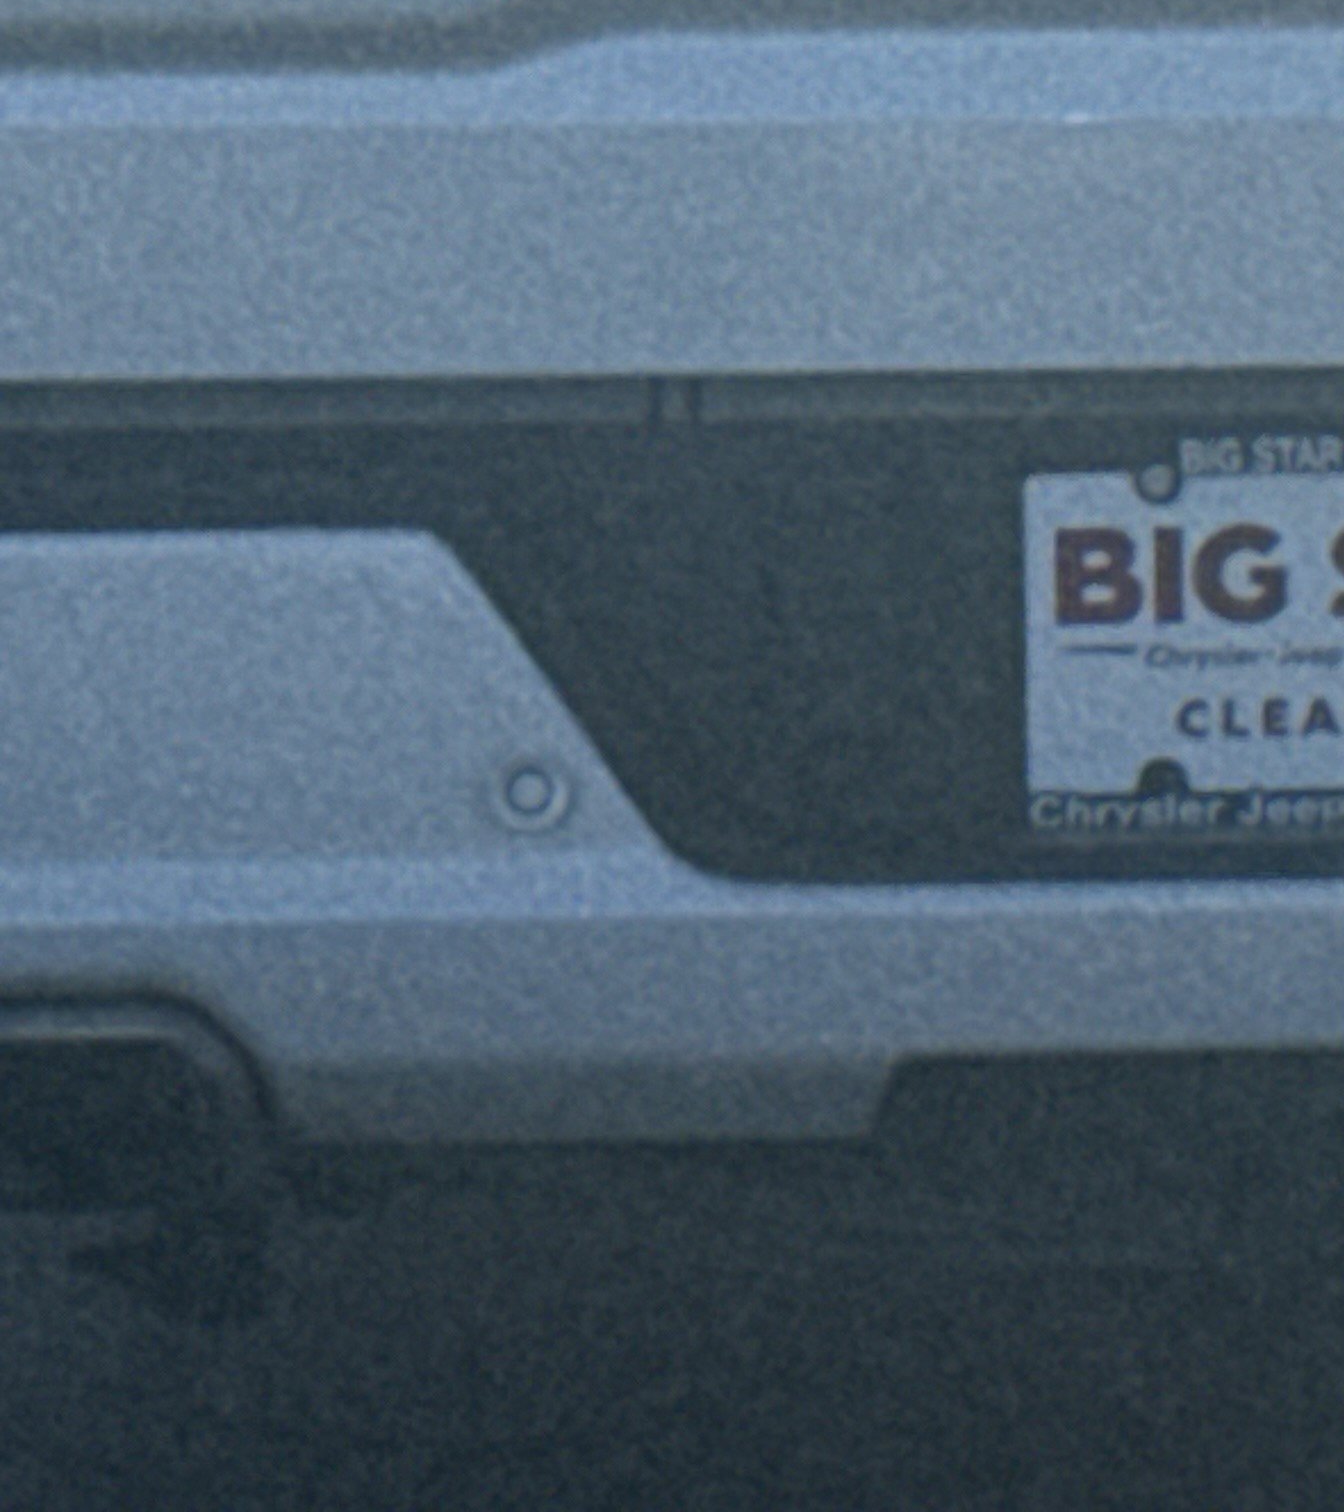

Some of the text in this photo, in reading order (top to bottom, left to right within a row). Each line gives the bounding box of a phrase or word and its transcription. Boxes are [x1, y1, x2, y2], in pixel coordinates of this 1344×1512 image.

[1178, 438, 1246, 474] BIG
[1053, 524, 1290, 626] BIG
[1030, 791, 1228, 830] Chrysler
